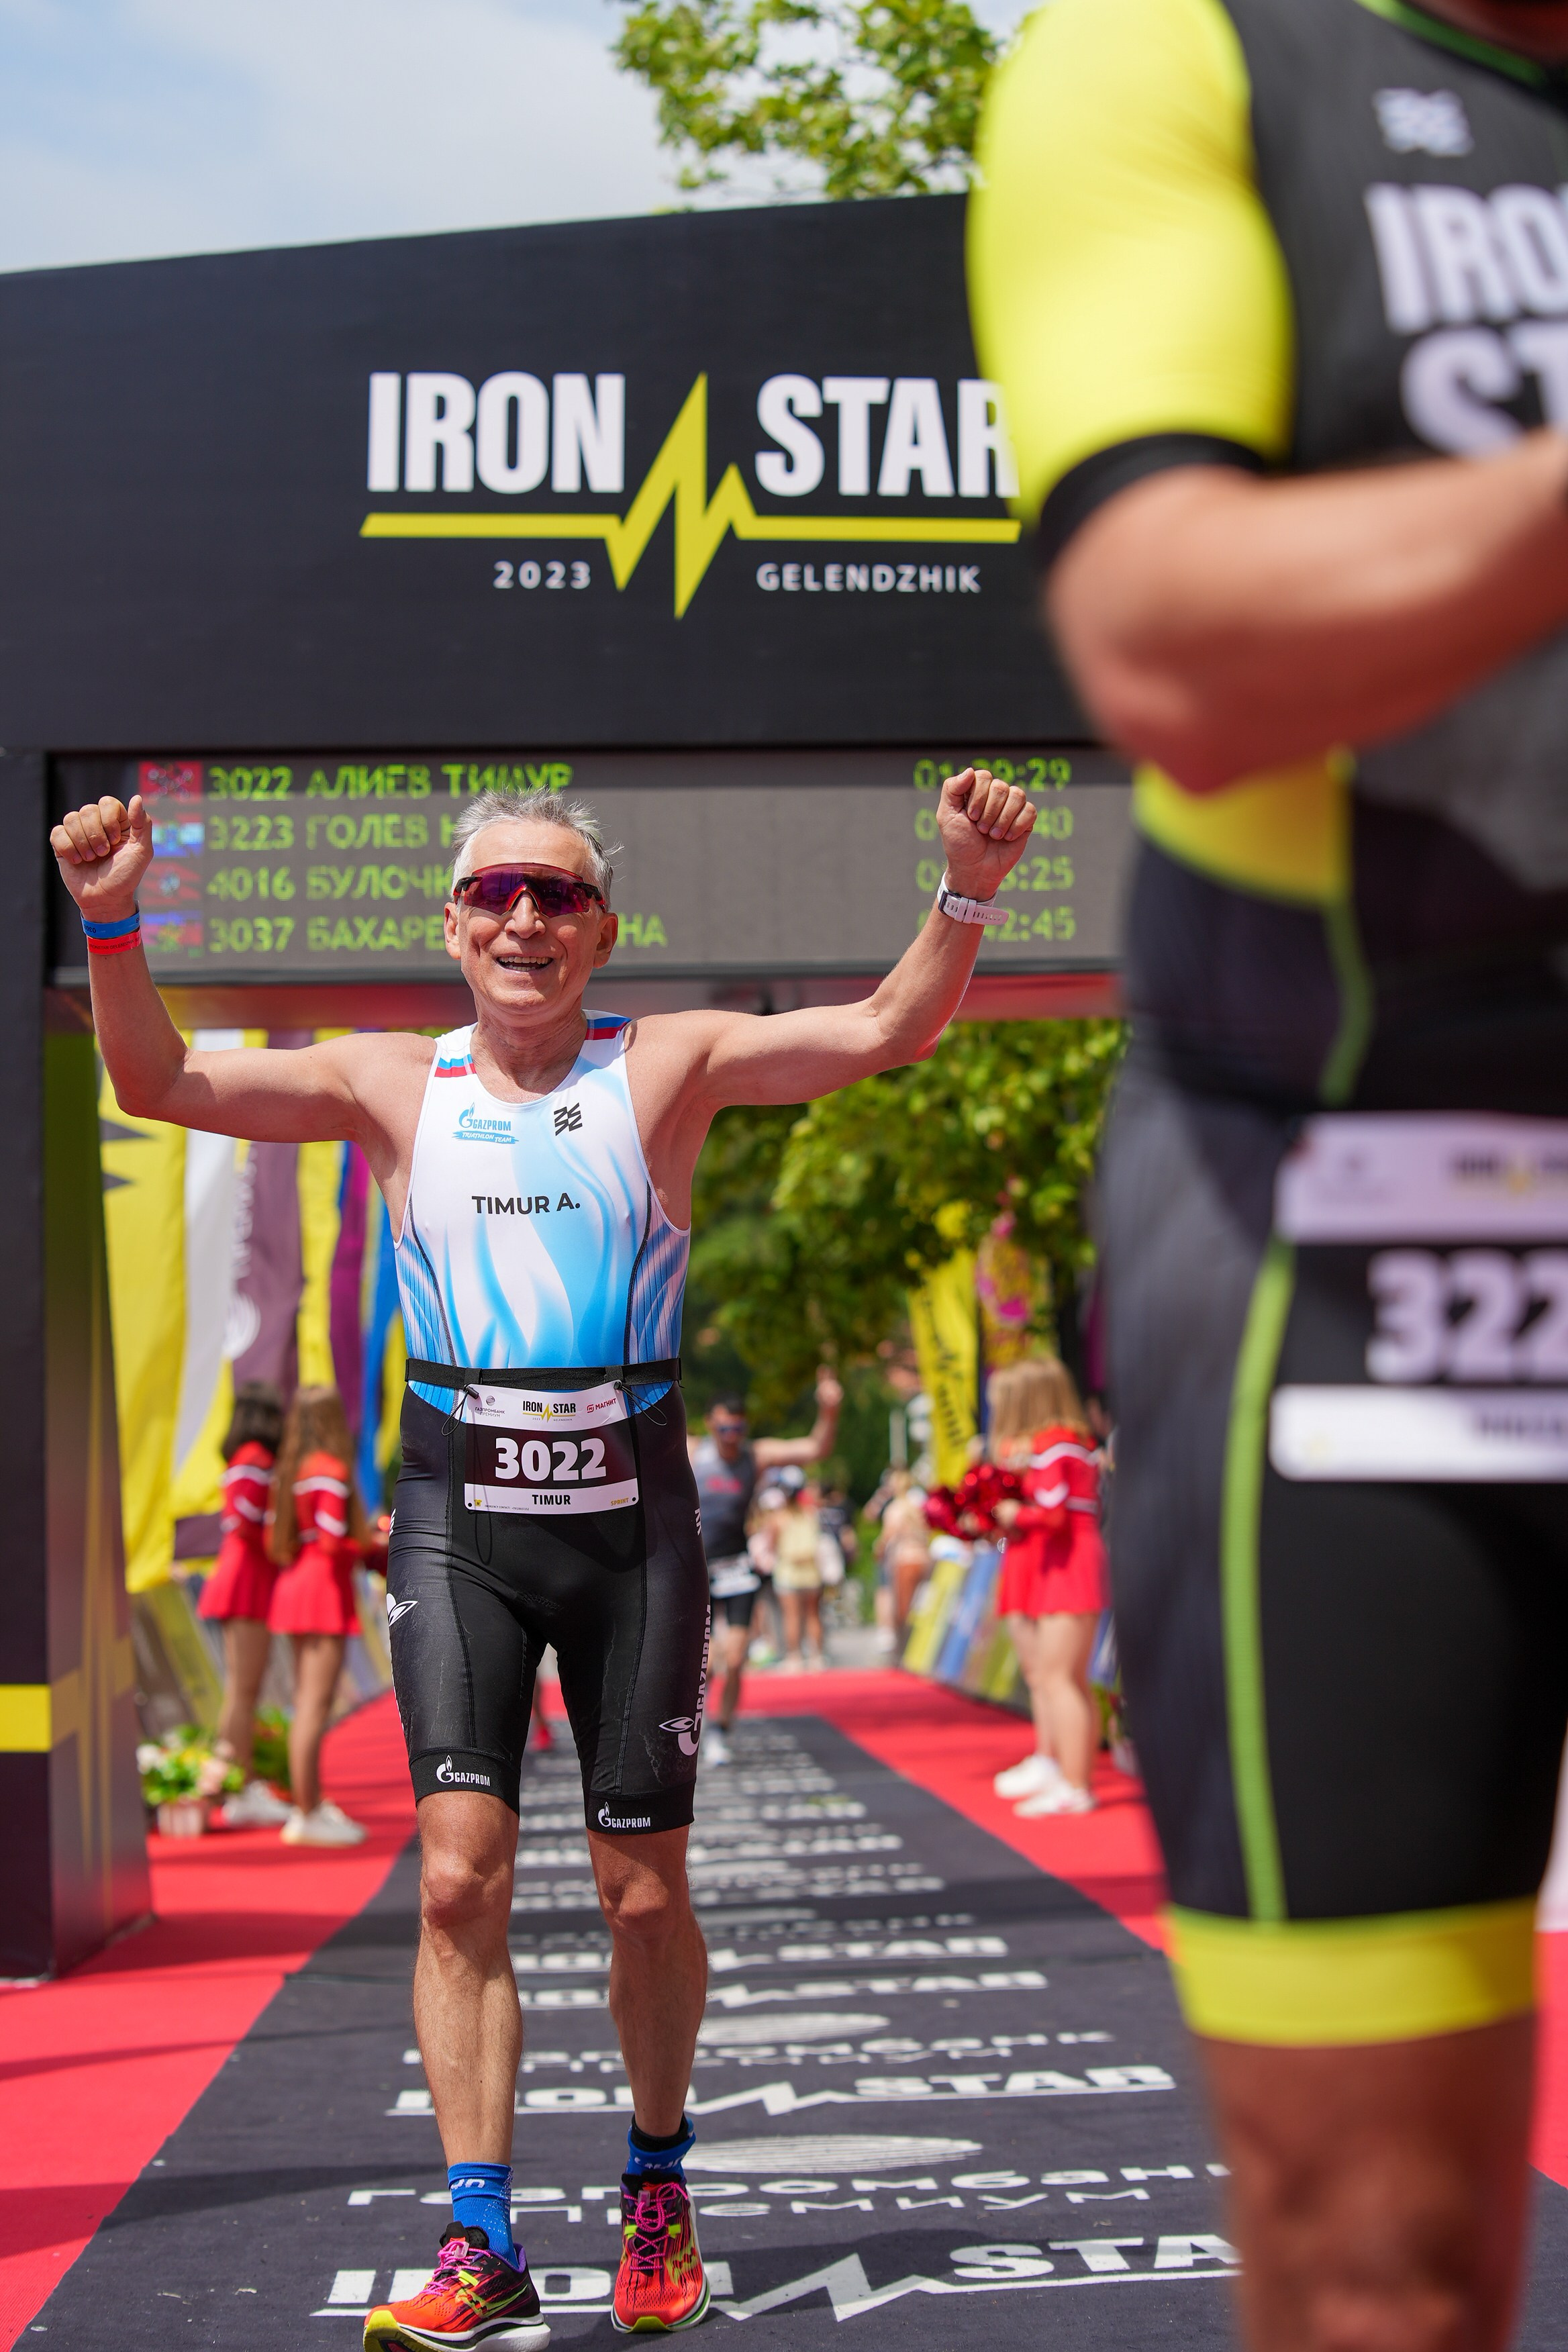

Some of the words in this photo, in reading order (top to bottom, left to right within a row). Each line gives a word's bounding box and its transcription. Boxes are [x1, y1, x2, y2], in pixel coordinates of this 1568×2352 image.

[1363, 181, 1568, 334] IRO
[1400, 326, 1568, 463] ST
[367, 371, 625, 493] IRON
[754, 374, 1020, 497] STAR
[493, 561, 591, 589] 2023
[756, 562, 981, 593] GELENDZHIK
[207, 765, 294, 801] 3022
[305, 764, 432, 800] АЛИЕВ
[207, 814, 295, 851] 3223
[305, 813, 430, 849] ГОЛЕВ
[206, 864, 296, 901] 4016
[305, 863, 452, 901] БУЛОЧК
[208, 916, 297, 953] 3037
[306, 914, 446, 952] БАХАРЕ
[473, 1119, 511, 1131] GAZPROM
[471, 1195, 550, 1214] TIMUR
[556, 1192, 581, 1212] A.
[1367, 1248, 1568, 1383] 322
[523, 1400, 542, 1413] IRON
[553, 1403, 576, 1414] STAR
[595, 1398, 617, 1410] МАГНИТ
[495, 1437, 607, 1481] 3022
[532, 1494, 571, 1506] TIMUR
[610, 1498, 629, 1506] SPRINT
[454, 1772, 491, 1787] GAZPROM
[611, 1816, 651, 1828] GAZPROM
[855, 2065, 1175, 2096] STAR
[949, 2233, 1247, 2280] STA
